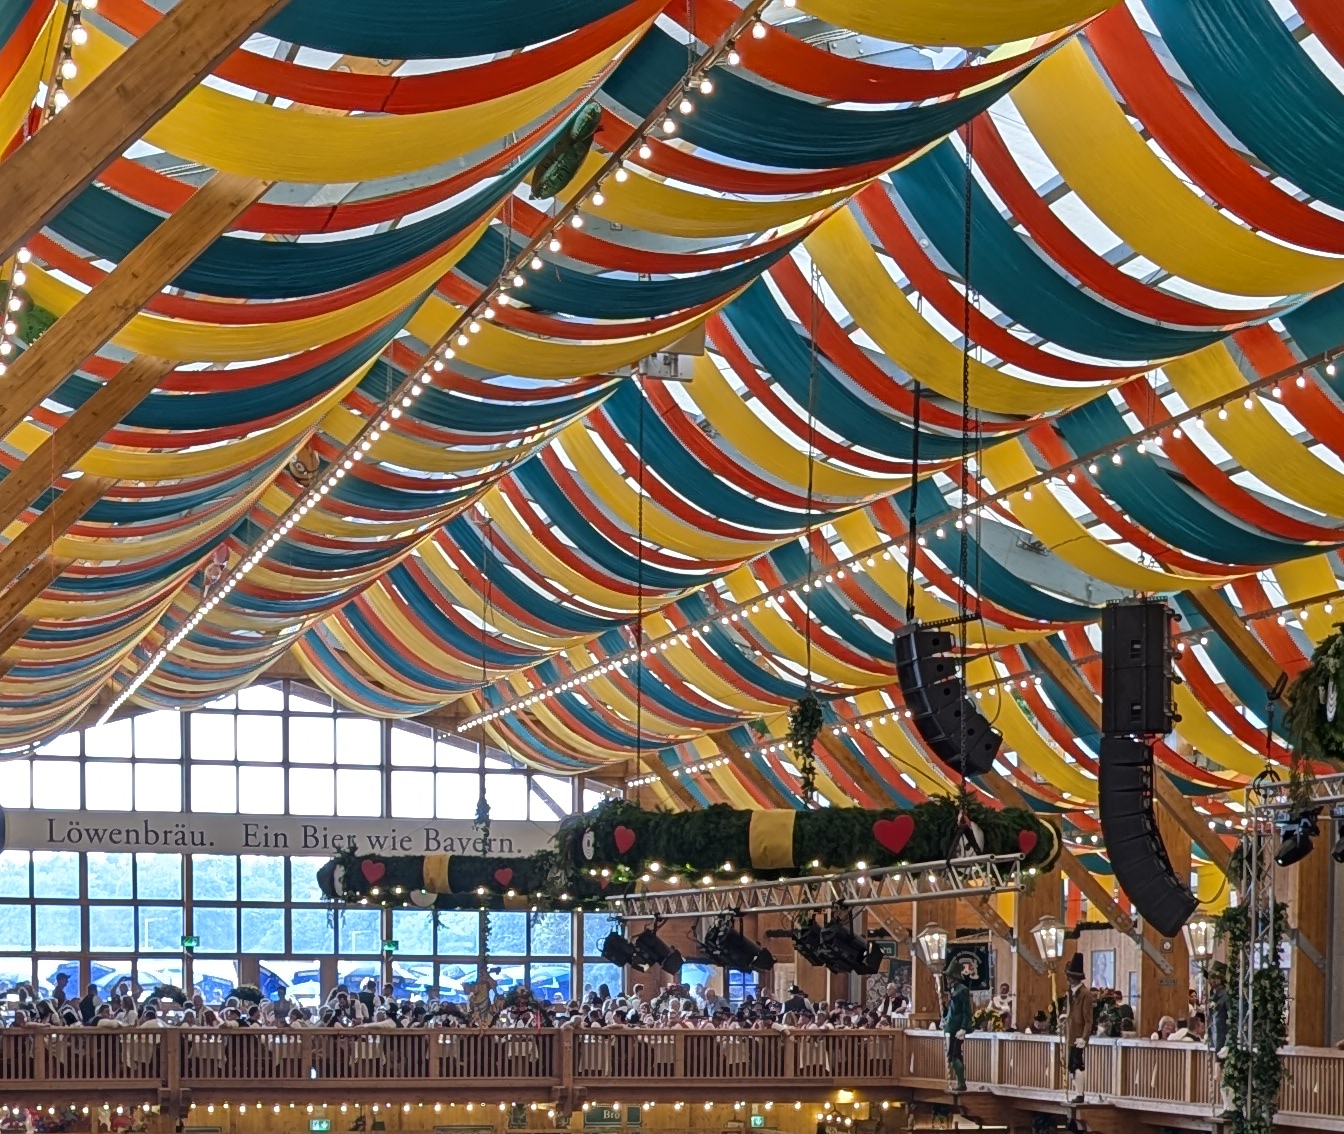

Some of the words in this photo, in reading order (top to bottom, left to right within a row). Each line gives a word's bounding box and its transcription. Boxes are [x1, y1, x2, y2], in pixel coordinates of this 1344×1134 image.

[47, 818, 214, 847] Löwenbräu.
[242, 823, 290, 849] Ein
[301, 824, 356, 850] Bier
[367, 828, 413, 852] wie
[424, 828, 523, 855] Bayern.
[603, 1109, 621, 1119] Bro
